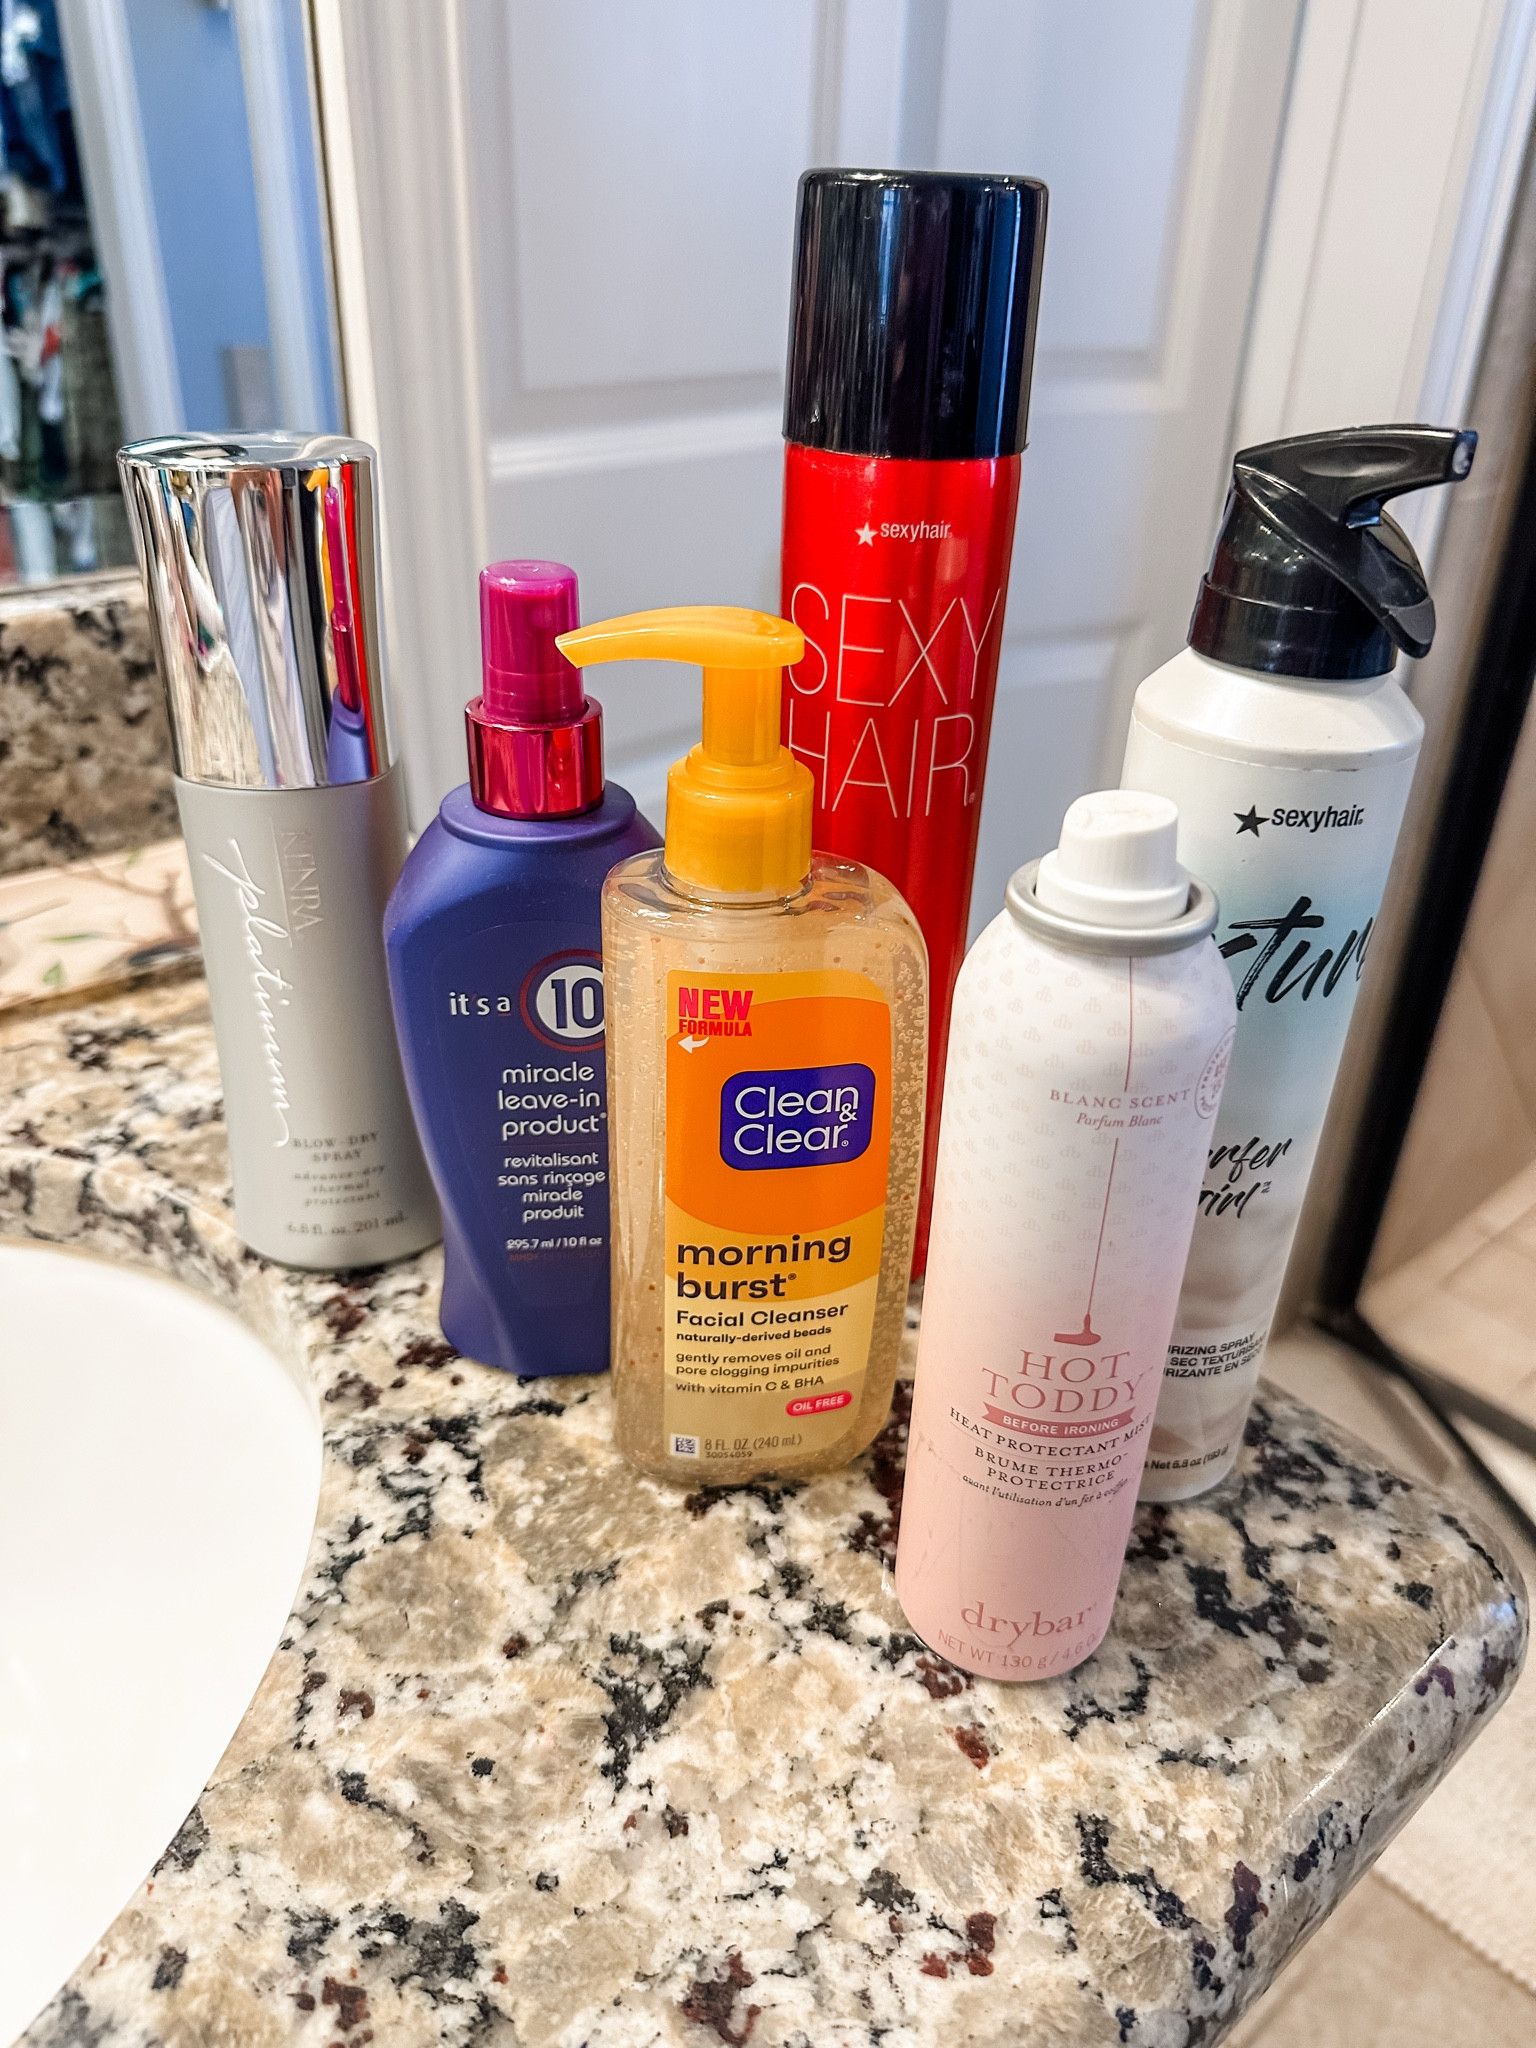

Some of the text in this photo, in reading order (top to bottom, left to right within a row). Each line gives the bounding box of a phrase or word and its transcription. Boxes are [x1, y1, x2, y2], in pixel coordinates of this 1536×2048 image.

[788, 582, 1001, 708] SEXY
[788, 698, 976, 819] HAIR
[202, 838, 293, 1148] platinum
[496, 996, 511, 1013] a
[551, 977, 605, 1030] 10
[678, 986, 754, 1021] NEW
[678, 1019, 753, 1037] FORMULA
[502, 1061, 595, 1084] miracle
[497, 1088, 601, 1111] leave-in
[734, 1085, 859, 1123] Clean &
[1050, 1088, 1191, 1109] BLANC SCENT
[1076, 1111, 1164, 1131] Parfum Blanc
[313, 1148, 361, 1162] SPRAY
[504, 1151, 600, 1169] revitalisant
[498, 1170, 607, 1188] sans rinçage
[522, 1187, 584, 1203] miracle
[523, 1205, 585, 1224] produit
[541, 1238, 555, 1249] ml
[563, 1236, 578, 1247] 10
[589, 1237, 603, 1245] oz
[677, 1233, 852, 1266] morning
[676, 1302, 849, 1327] Facial Cleanser
[675, 1325, 832, 1344] naturally-derived beads
[1219, 1331, 1256, 1352] SPRAY
[675, 1344, 832, 1365] gently removes oil and
[1170, 1356, 1198, 1367] SEC
[675, 1356, 840, 1378] pore clogging impurities
[1017, 1349, 1131, 1383] HOT
[1163, 1366, 1222, 1378] RIZANTE
[1224, 1361, 1239, 1373] EN
[675, 1375, 825, 1394] with vitamin C & BHA
[981, 1366, 1154, 1414] TODDY
[792, 1394, 846, 1412] OIL FREE
[950, 1406, 1152, 1457] HEAT PROTECTANT MIST
[1003, 1415, 1120, 1435] BEFORE IRONING
[704, 1438, 713, 1451] 8
[975, 1446, 1039, 1476] BRUME
[1150, 1460, 1171, 1469] Net
[987, 1467, 1115, 1491] PROTECTRICE
[960, 1600, 1089, 1648] drybar
[938, 1628, 966, 1653] NET
[970, 1645, 996, 1663] WT
[1002, 1655, 1032, 1667] 130
